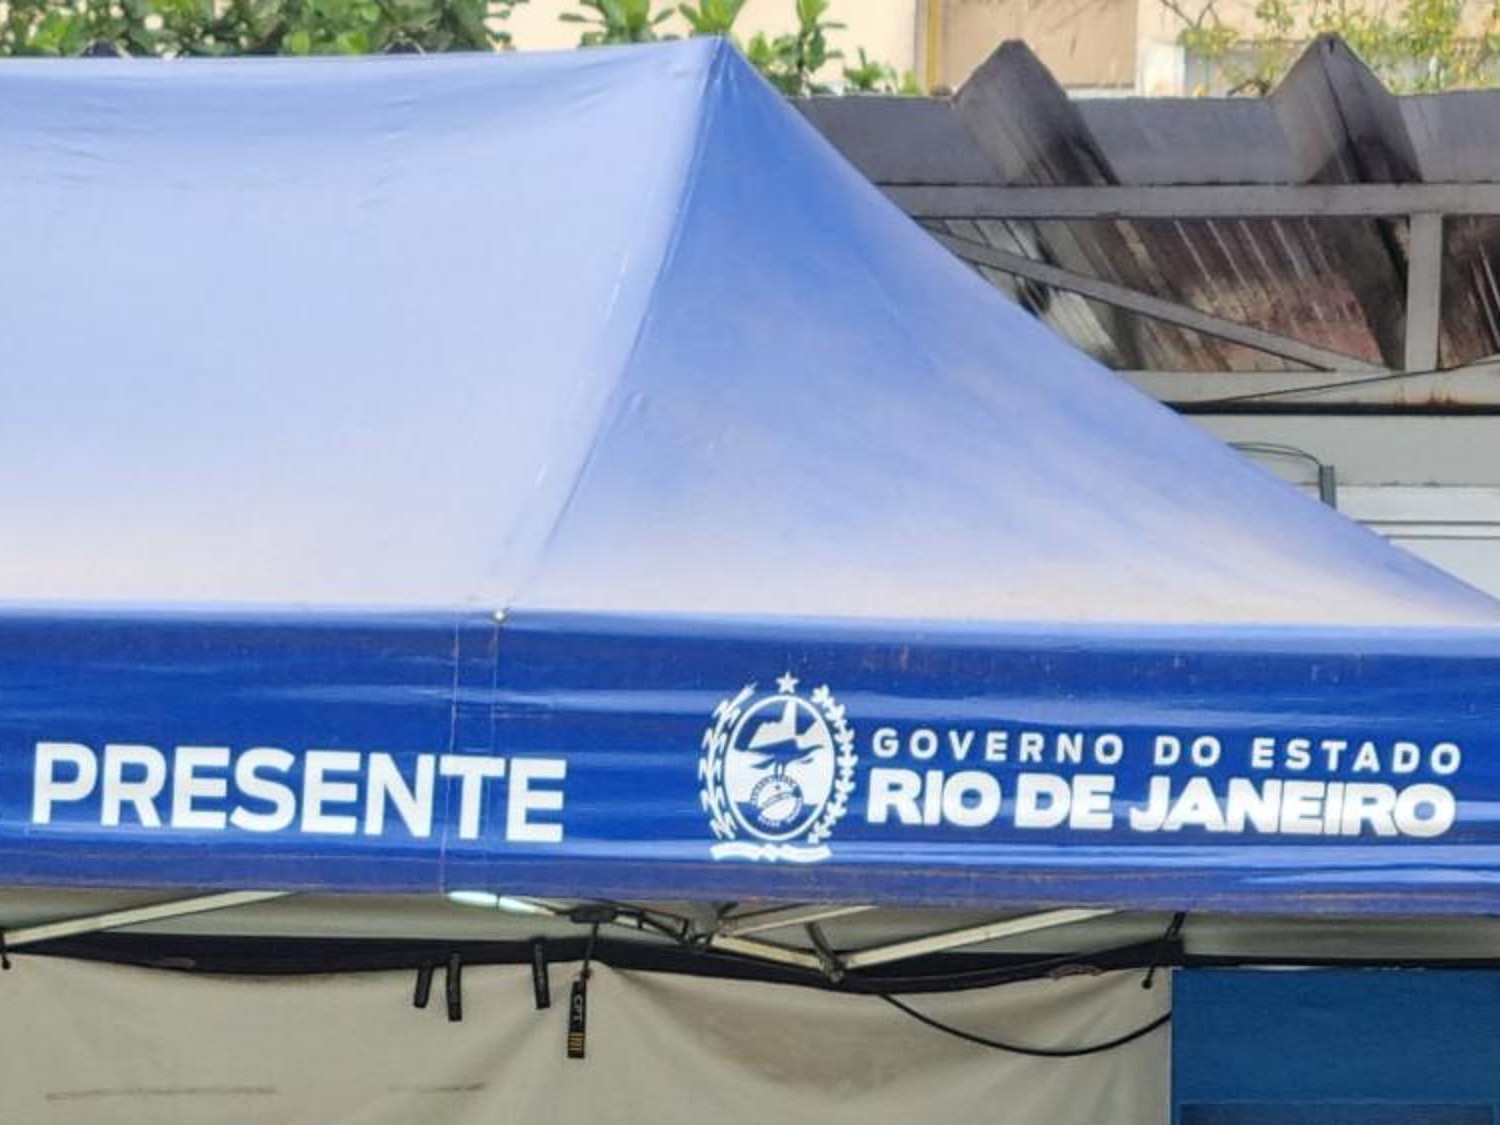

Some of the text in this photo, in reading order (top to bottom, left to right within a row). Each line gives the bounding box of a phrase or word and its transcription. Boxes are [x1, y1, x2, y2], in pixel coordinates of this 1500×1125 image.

[872, 728, 1462, 775] GOVERNO DO ESTADO
[31, 742, 567, 843] PRESENTE
[867, 768, 1002, 827] RIO
[1014, 772, 1116, 831] DE
[1129, 775, 1457, 838] JANEIRO
